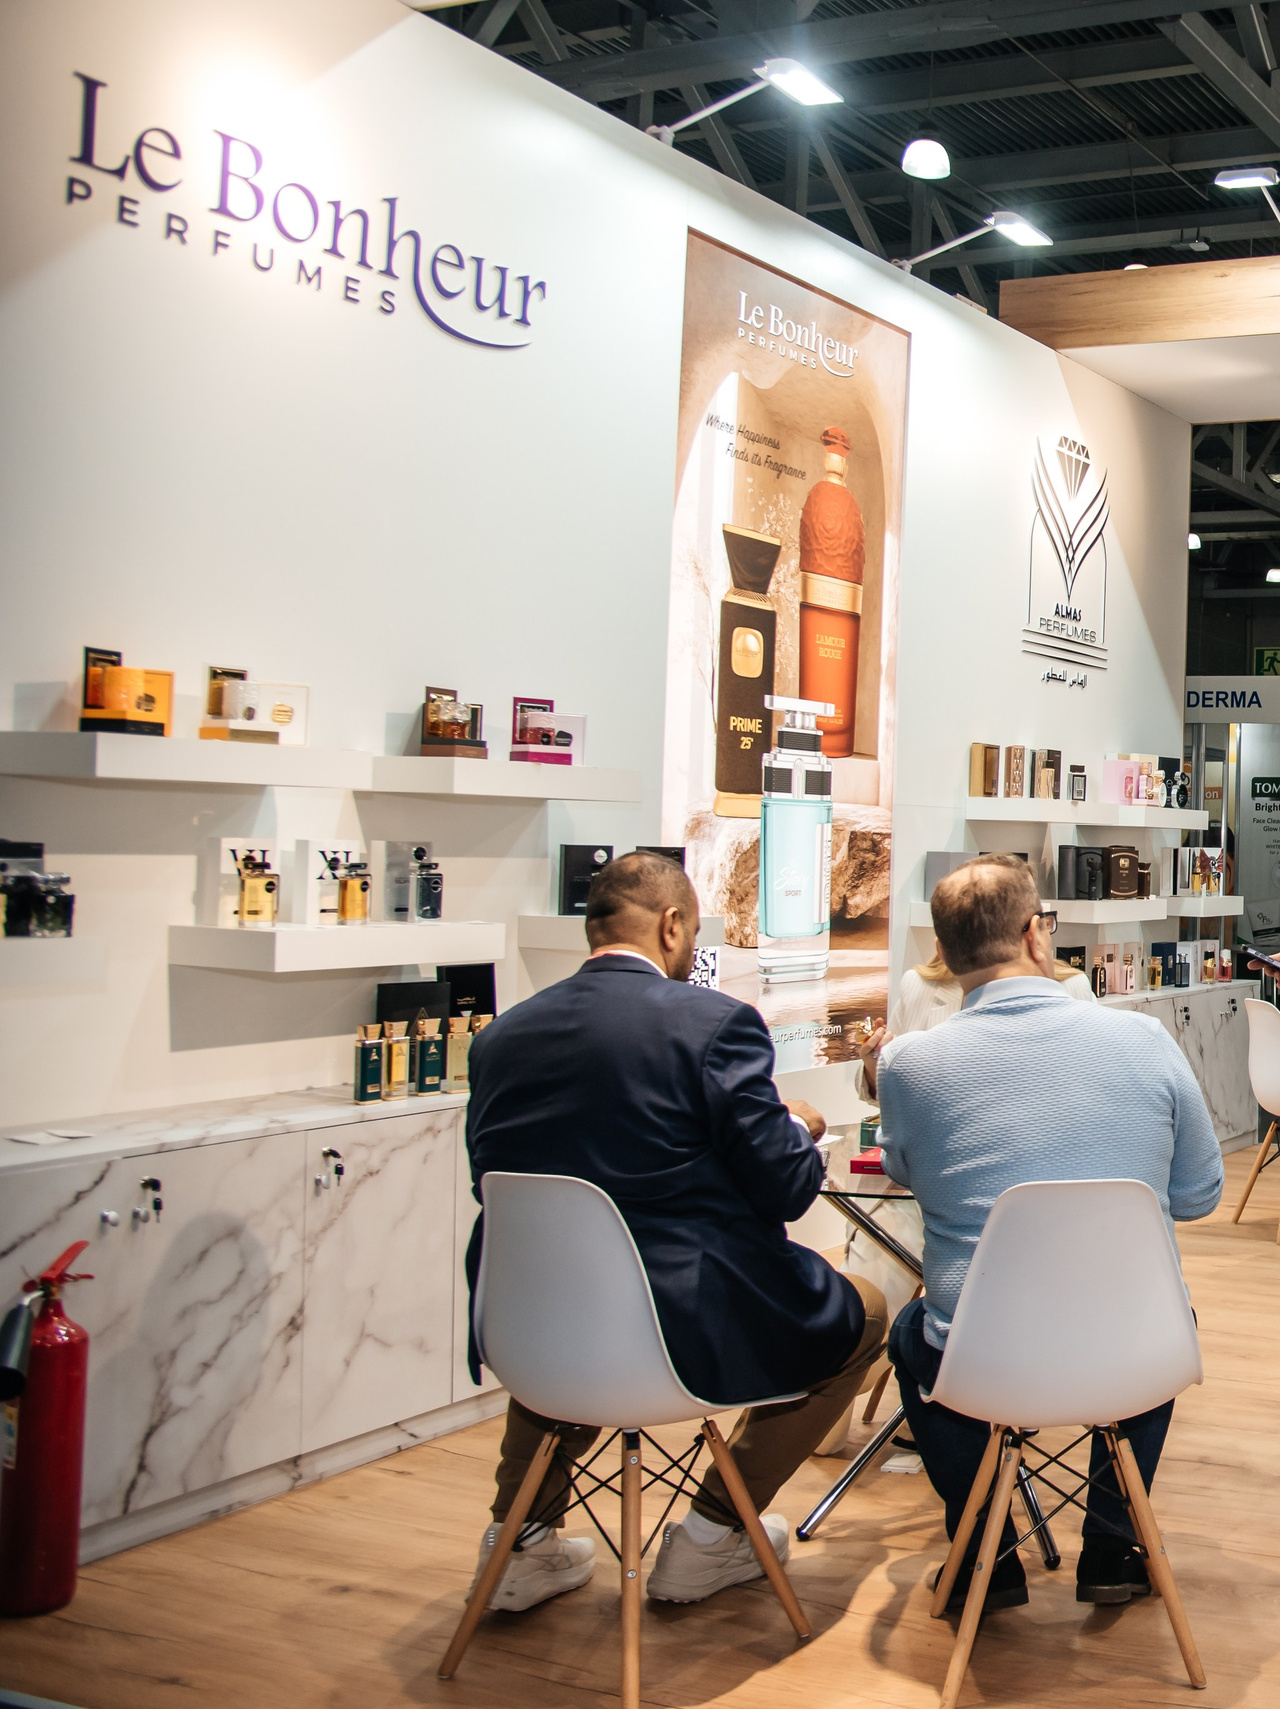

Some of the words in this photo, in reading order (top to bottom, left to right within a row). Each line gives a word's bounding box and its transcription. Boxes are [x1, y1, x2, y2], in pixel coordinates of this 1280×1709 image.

[69, 71, 183, 193] Le
[208, 129, 547, 350] Bonheur
[66, 176, 397, 315] PERFUMES
[738, 290, 764, 329] Le
[768, 303, 859, 377] Bonheur
[738, 327, 817, 369] PERFUMES
[706, 413, 735, 434] Where
[736, 423, 780, 450] Happiness
[726, 442, 749, 462] Finds
[751, 453, 762, 467] its
[763, 455, 807, 480] Fragrance
[1054, 602, 1082, 622] ALMAS
[1039, 617, 1097, 643] PERFUMES
[1186, 690, 1263, 708] DERMA
[729, 715, 763, 734] PRIME
[784, 889, 802, 897] SPORT
[769, 1024, 843, 1045] eurperfumes.com
